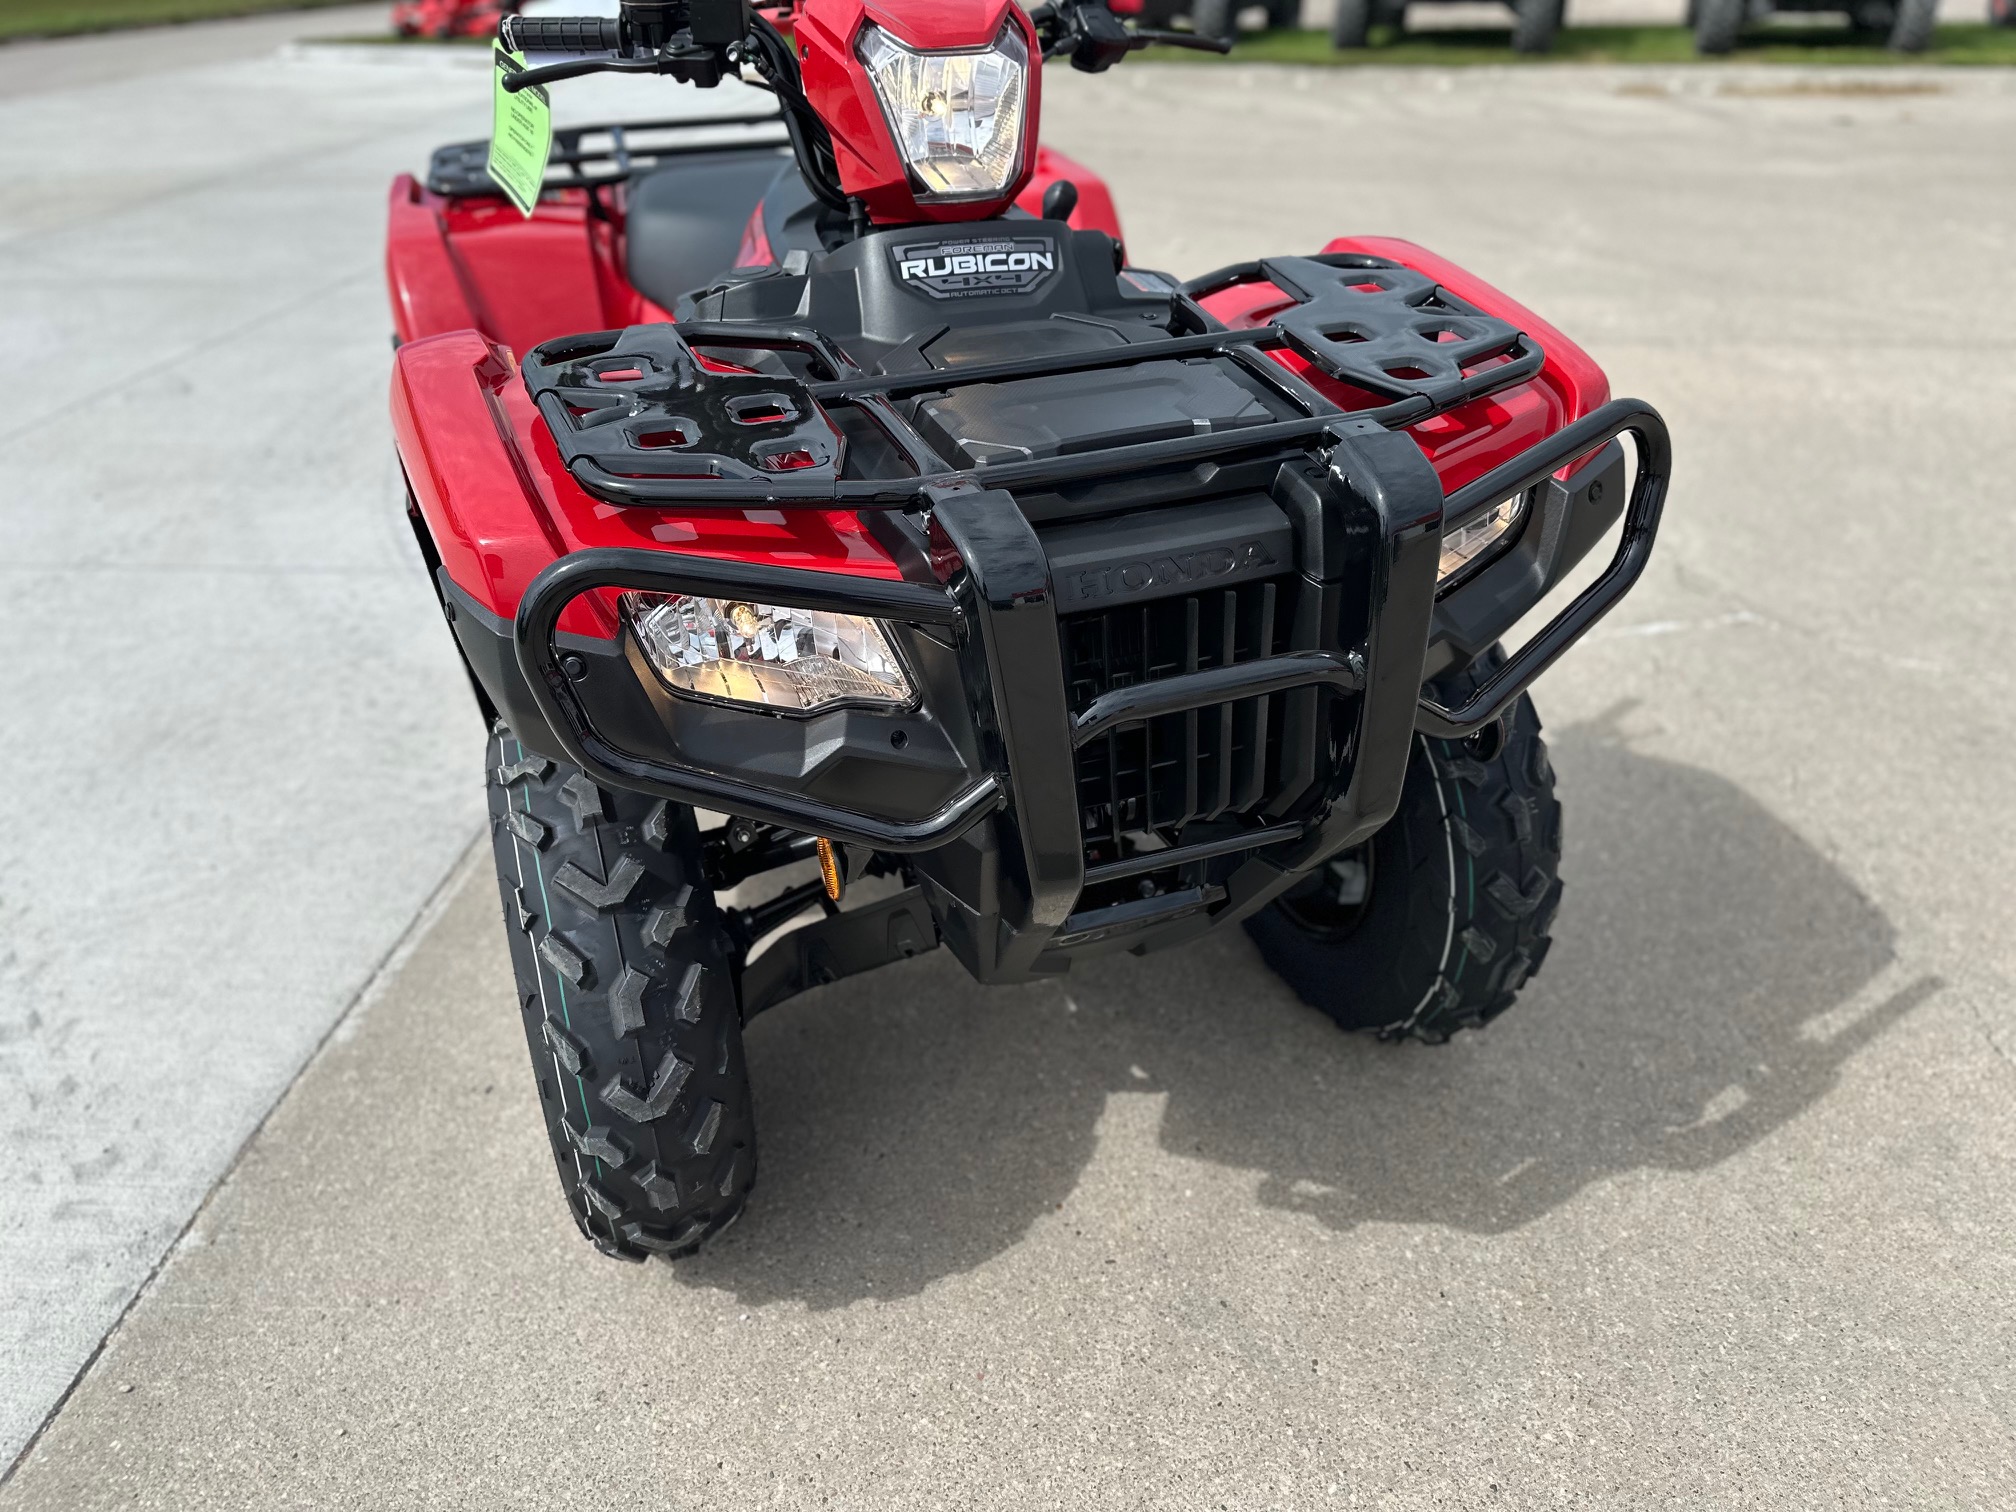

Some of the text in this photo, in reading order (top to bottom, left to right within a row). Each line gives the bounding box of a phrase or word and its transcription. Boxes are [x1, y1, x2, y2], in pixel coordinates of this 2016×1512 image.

[940, 243, 1015, 255] FOREMAN
[900, 252, 1054, 280] RUBICON
[951, 288, 1000, 297] AUTOMATIC
[1066, 540, 1279, 600] HONDA
